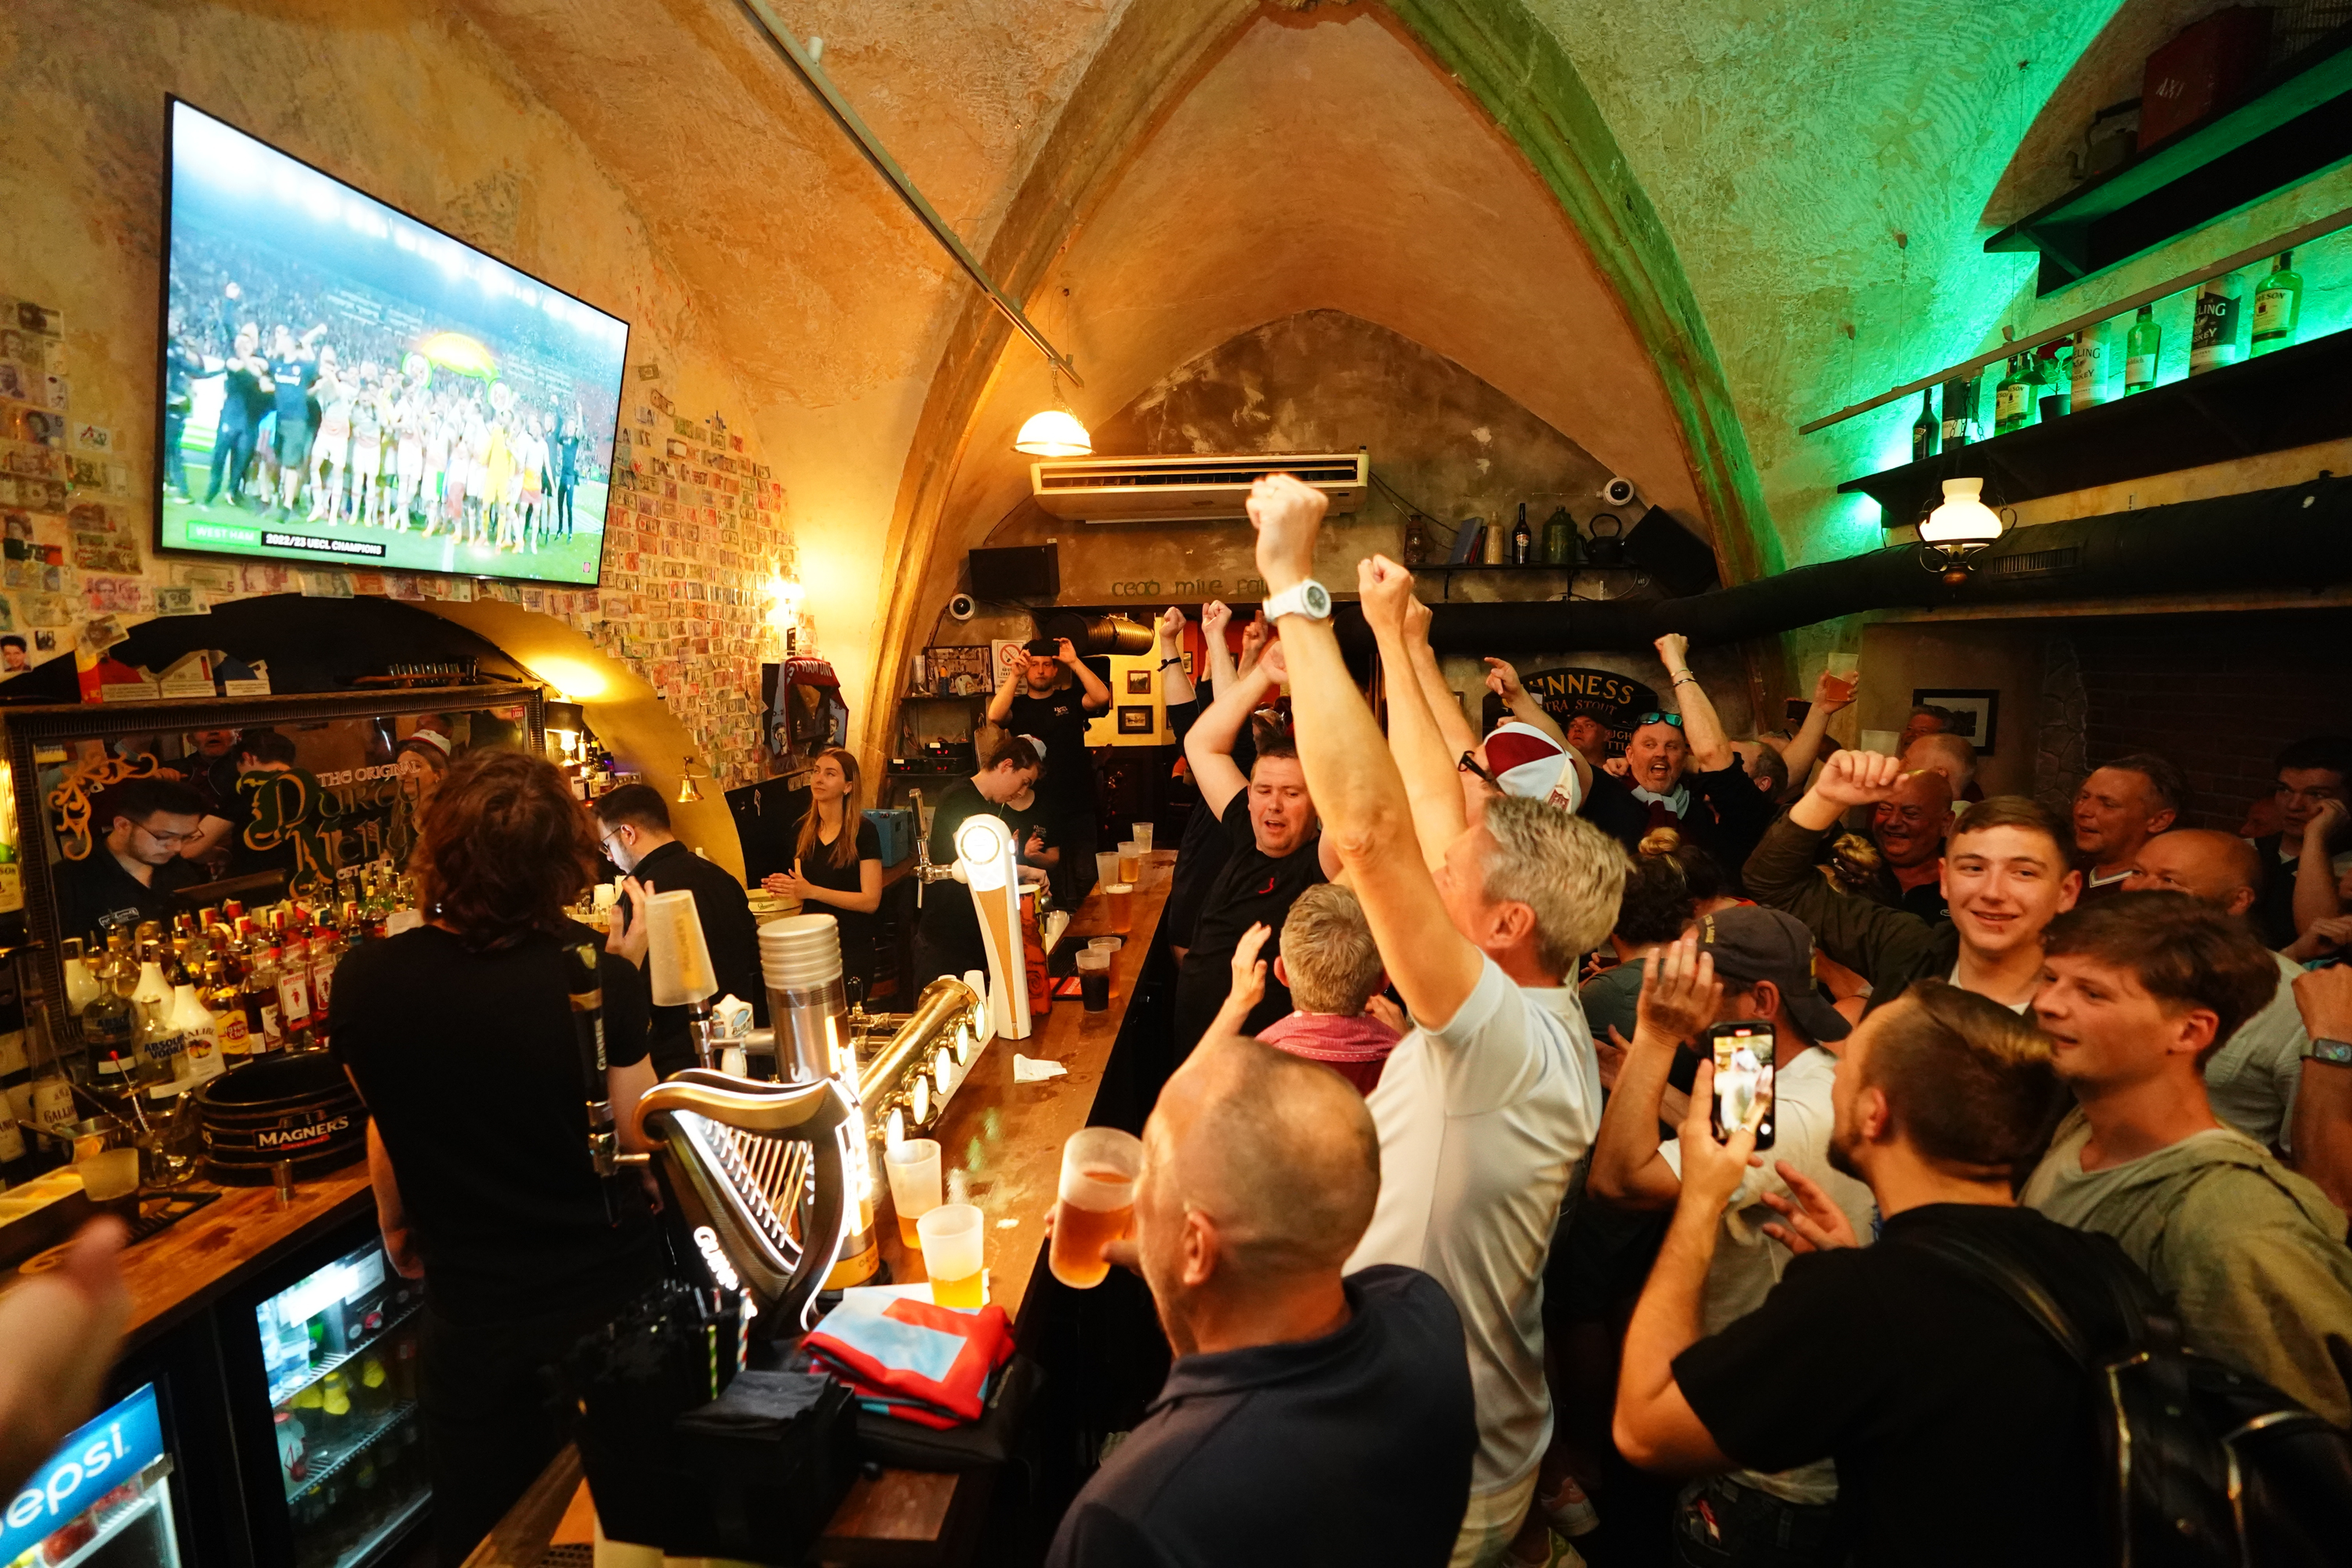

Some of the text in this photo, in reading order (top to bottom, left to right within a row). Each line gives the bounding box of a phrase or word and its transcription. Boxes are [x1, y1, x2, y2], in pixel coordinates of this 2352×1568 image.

[2196, 303, 2226, 316] LING
[2194, 328, 2217, 342] SKEY
[2074, 368, 2094, 381] SKEY
[195, 526, 255, 541] WEST HAM
[266, 533, 383, 555] 2022/23 UECL CHAMPIONS
[1544, 699, 1569, 713] TRA
[1612, 730, 1632, 741] UGH
[315, 760, 421, 787] THE ORIGINAL
[258, 1116, 350, 1148] MAGNERS
[0, 1422, 124, 1537] epsi
